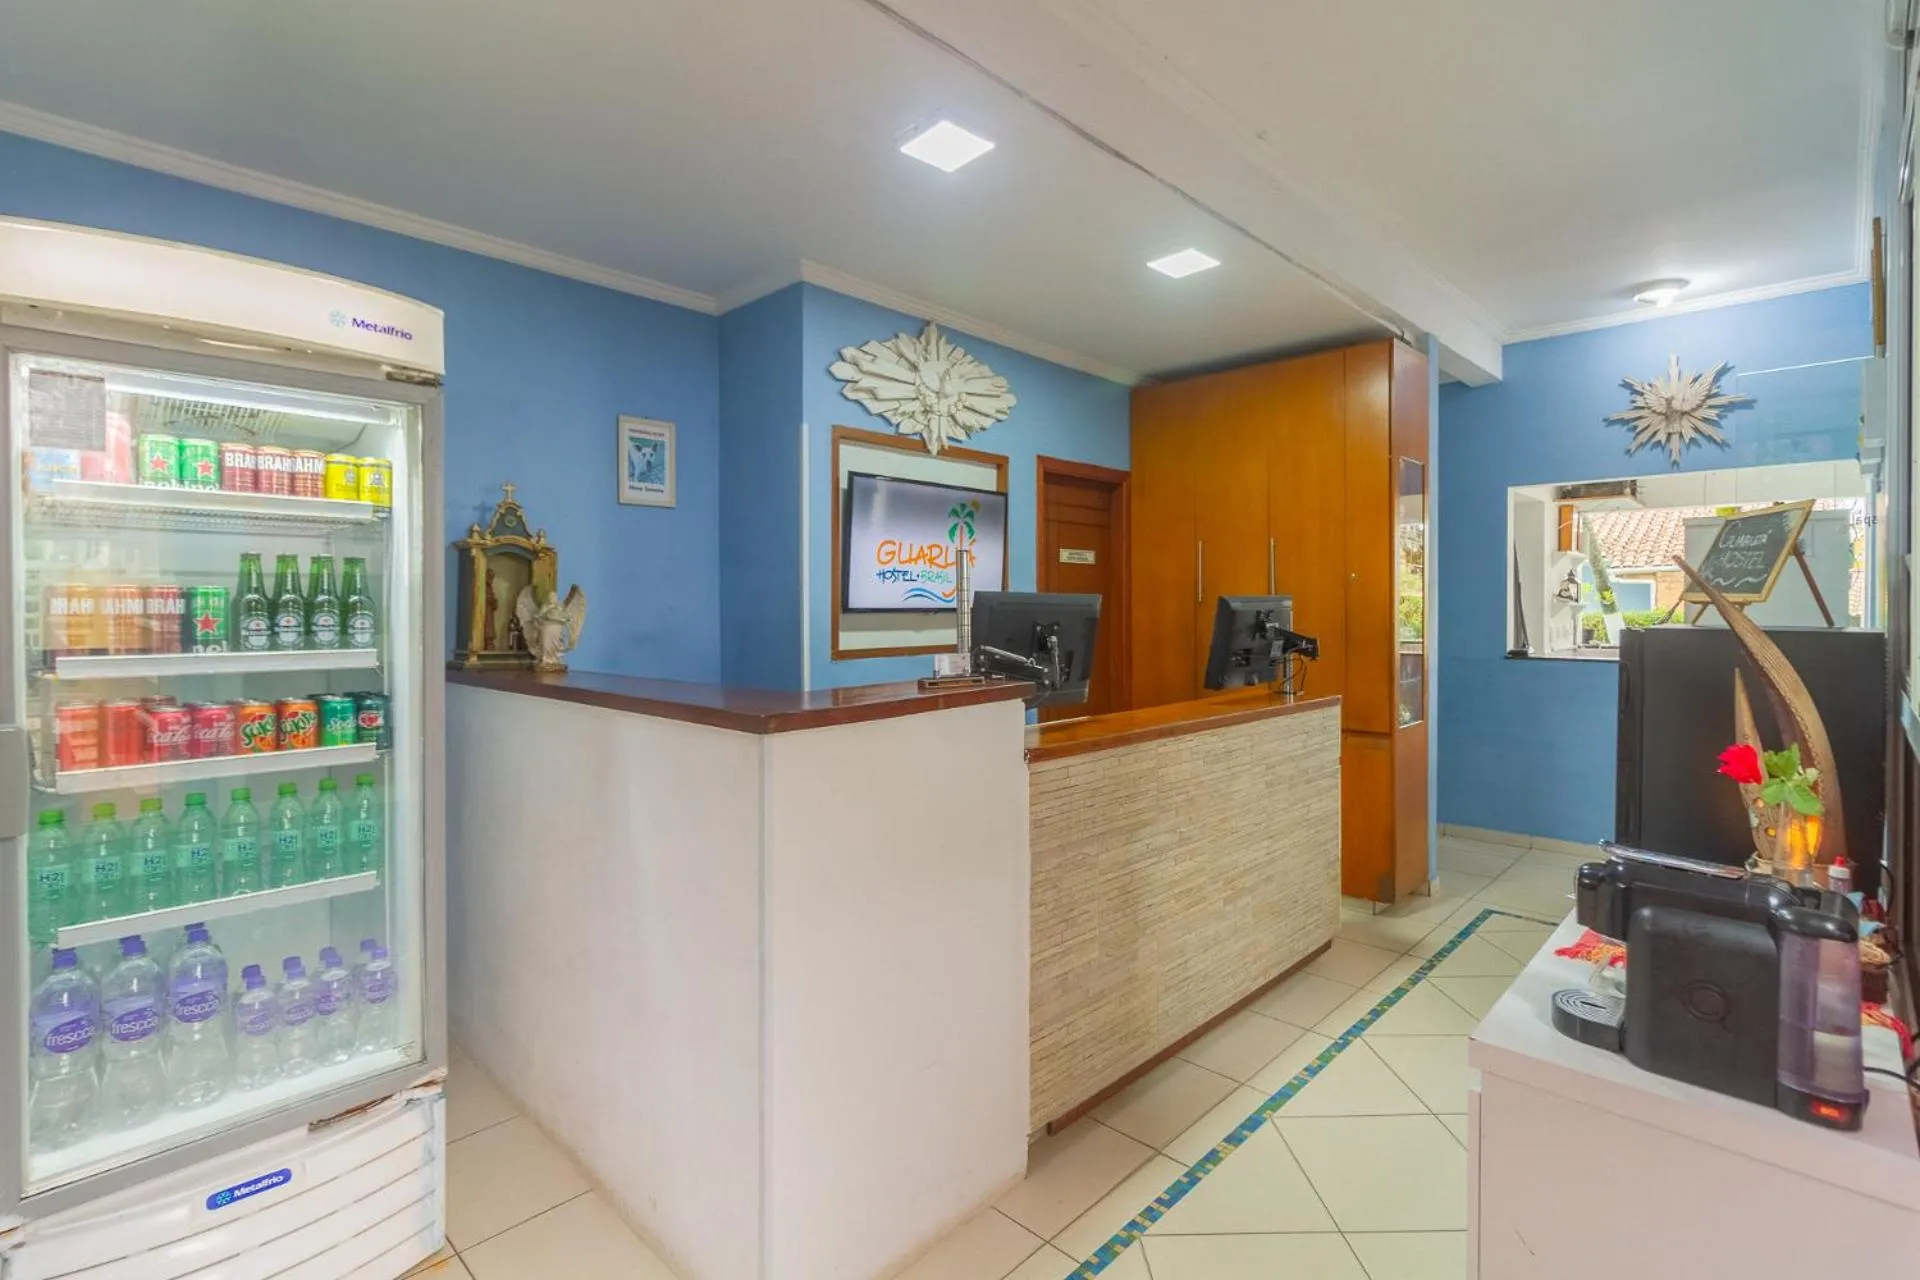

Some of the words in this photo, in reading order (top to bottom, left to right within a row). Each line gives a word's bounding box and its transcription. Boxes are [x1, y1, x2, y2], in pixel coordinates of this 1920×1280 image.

[351, 317, 414, 341] Metalfrio
[875, 566, 918, 584] HOSTEL
[232, 1174, 284, 1198] Metalfrio
